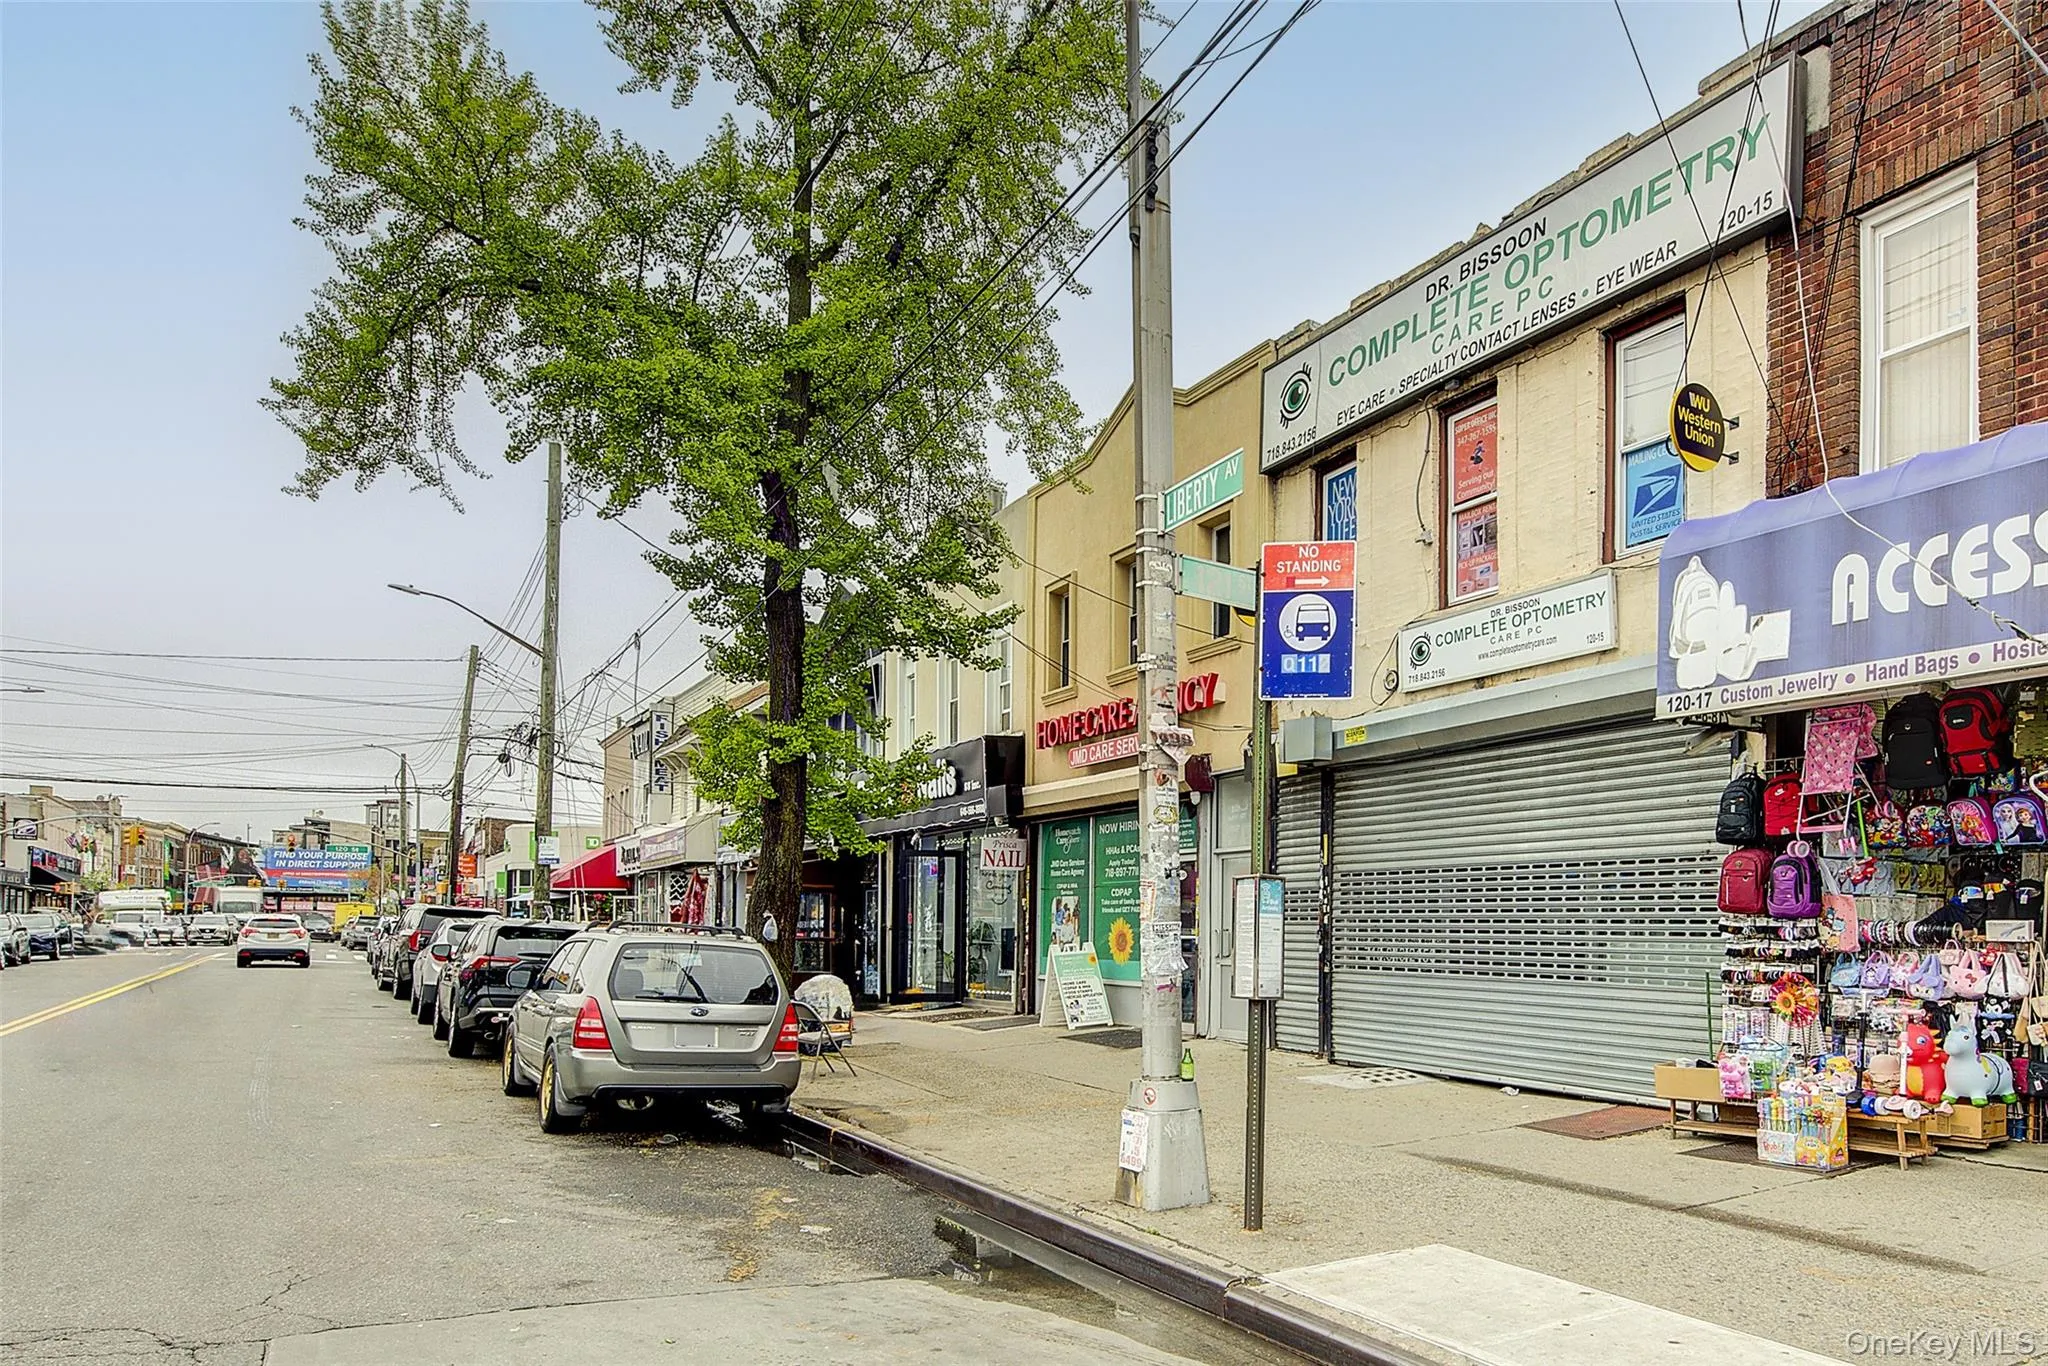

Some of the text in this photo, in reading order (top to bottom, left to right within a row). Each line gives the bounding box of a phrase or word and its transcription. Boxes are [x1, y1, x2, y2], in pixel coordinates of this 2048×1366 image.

[1718, 190, 1773, 233] 120-15
[1328, 112, 1771, 386] COMPLETE OPTOMETRY
[1426, 217, 1547, 303] DR. BISSOON
[1336, 240, 1678, 427] EYE CARE SPECIALTY CONTACT LENSES EYE WEAR
[1431, 301, 1504, 354] CARE
[1677, 404, 1722, 435] Western
[1266, 426, 1317, 463] 718.843.2156
[1685, 424, 1715, 449] Union
[1628, 448, 1657, 467] MAILING
[1167, 459, 1239, 524] LIBERTY AV
[1631, 508, 1682, 530] UNITED STATES
[1629, 525, 1654, 540] POSTAL
[1299, 546, 1319, 559] NO
[1276, 559, 1342, 574] STANDING
[1490, 597, 1541, 619] DR. BISSOON
[1435, 591, 1606, 648] COMPLETE OPTOMETRY
[1490, 630, 1520, 645] CARE
[1586, 631, 1605, 645] 120-15
[1282, 655, 1318, 672] Q11
[1666, 692, 1713, 714] 120-17
[1720, 684, 1773, 706] Custom
[1777, 670, 1839, 700] Jewelry
[1865, 662, 1909, 683] Hand
[1914, 653, 1960, 676] Bags
[1070, 748, 1088, 767] JMD
[1089, 742, 1114, 761] CARE
[1099, 824, 1118, 835] NOW
[274, 851, 368, 861] FIND YOUR PURPOSE
[288, 860, 321, 868] DIRECT
[323, 861, 367, 869] SUPPORT
[983, 849, 1025, 868] NAIL
[1111, 888, 1133, 897] CDPAP
